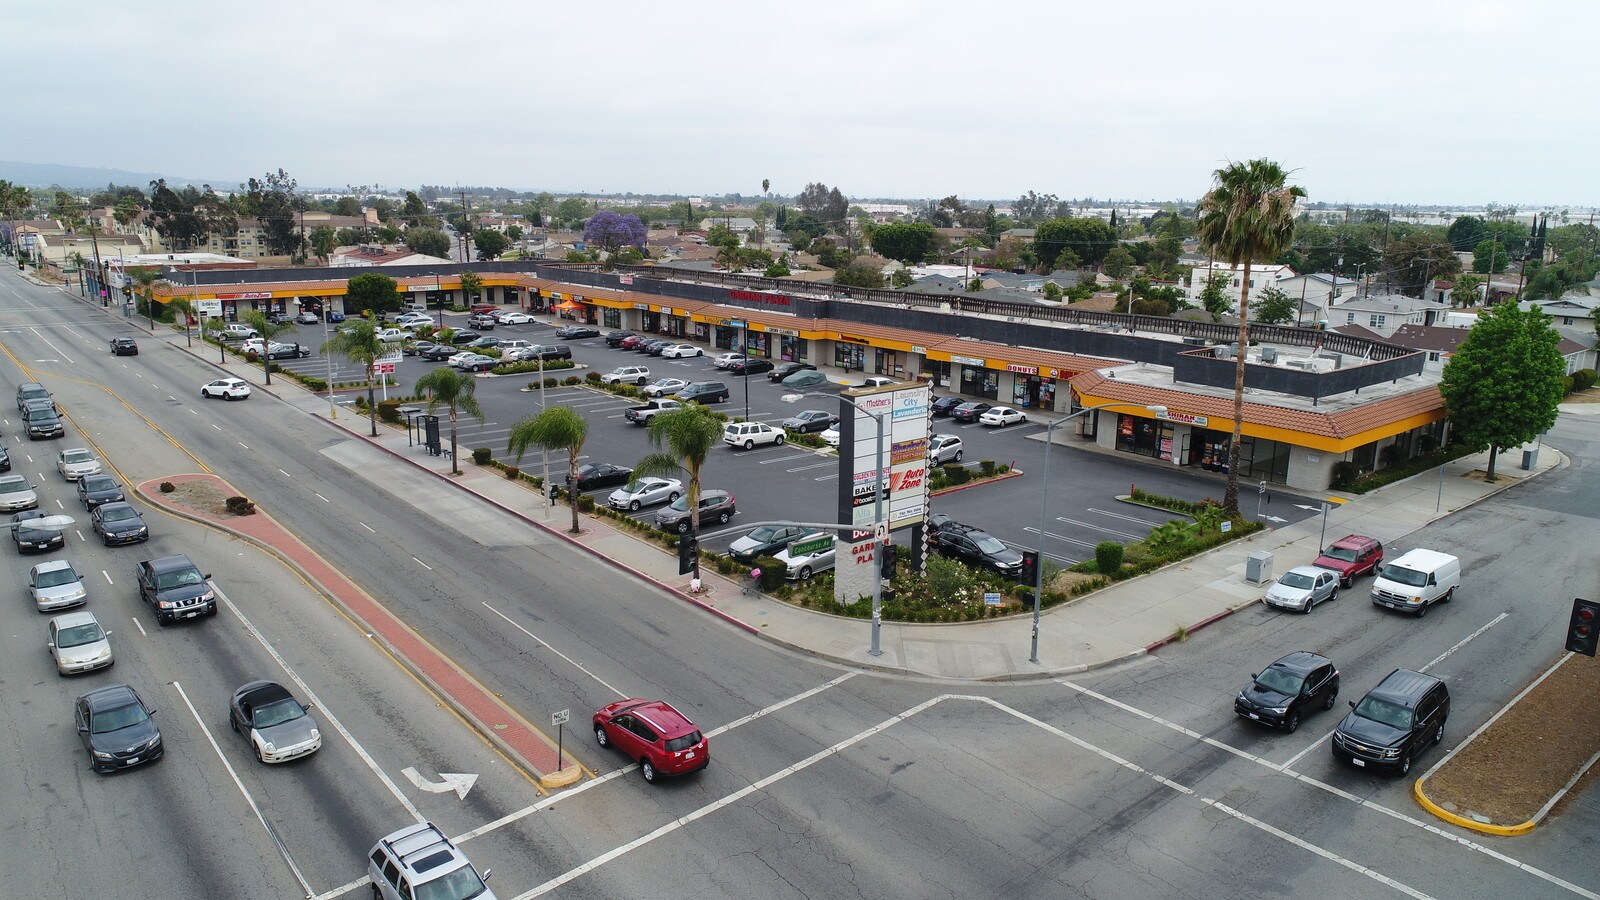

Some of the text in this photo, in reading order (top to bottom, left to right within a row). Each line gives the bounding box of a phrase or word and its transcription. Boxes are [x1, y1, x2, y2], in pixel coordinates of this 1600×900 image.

[765, 294, 791, 306] PLAZA
[1007, 364, 1037, 375] DONUTS
[895, 389, 927, 400] Laundry
[866, 398, 891, 408] Mother's
[904, 398, 918, 407] City
[894, 407, 927, 418] Lavanderia
[904, 468, 924, 480] Auto
[854, 482, 888, 495] BAKEY
[899, 478, 921, 490] Zone
[794, 543, 821, 554] Concourse
[553, 712, 562, 720] NO
